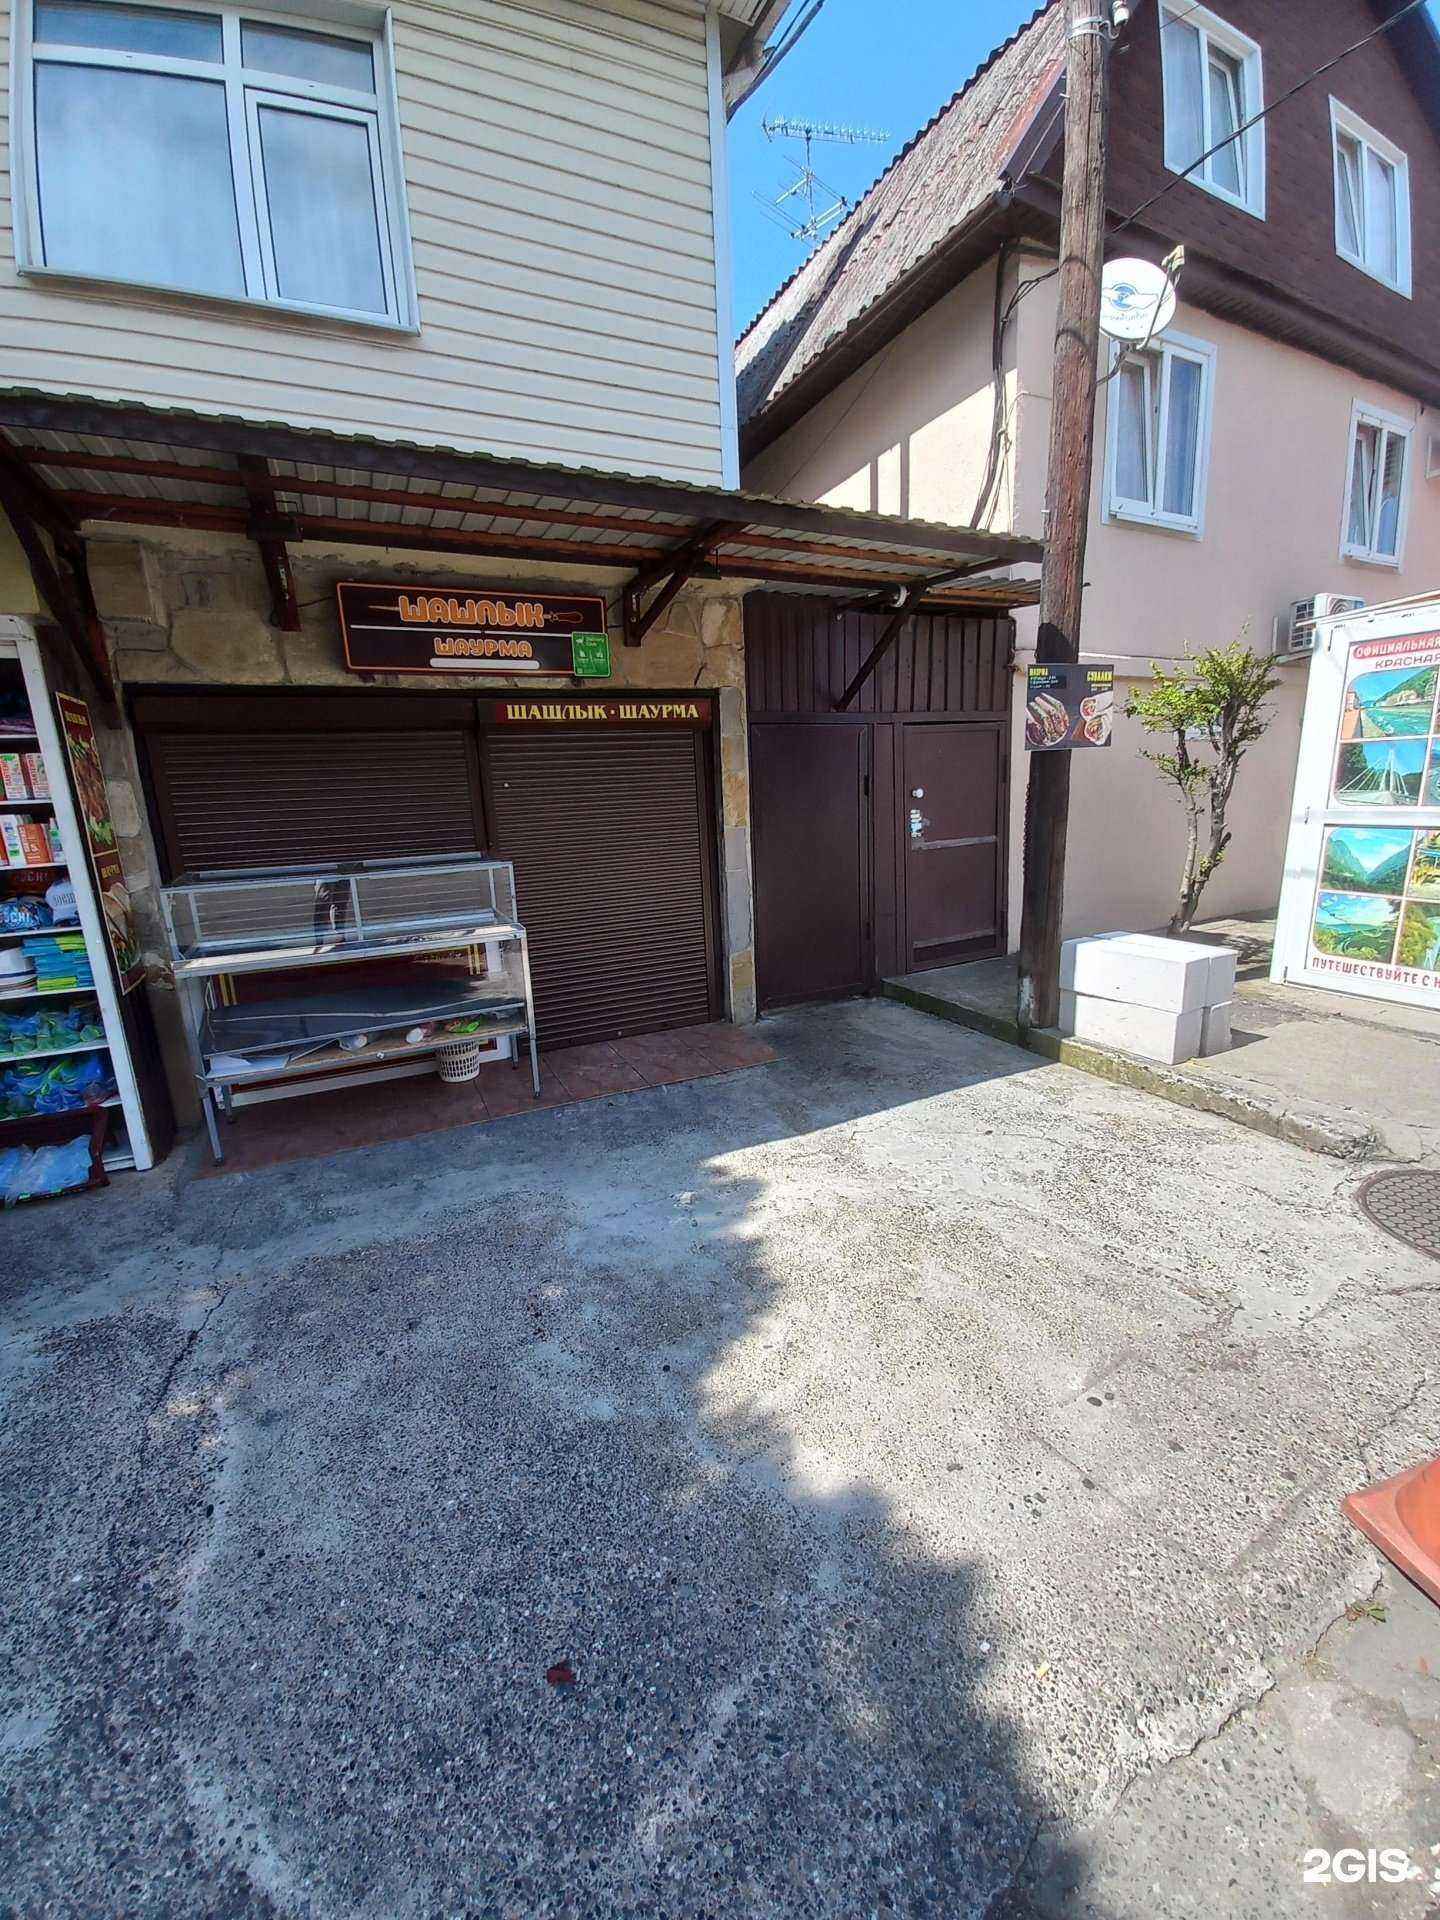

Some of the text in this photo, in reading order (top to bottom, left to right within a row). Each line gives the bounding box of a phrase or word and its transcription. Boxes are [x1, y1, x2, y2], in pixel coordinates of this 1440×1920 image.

[399, 595, 544, 628] ШАШЛЫК
[434, 638, 532, 658] ШАУРМА
[507, 703, 699, 720] ШАШЛЫК ШАУРМА
[1312, 957, 1418, 984] ПУТЕШЕСТВУЙТЕ
[1422, 975, 1430, 987] С
